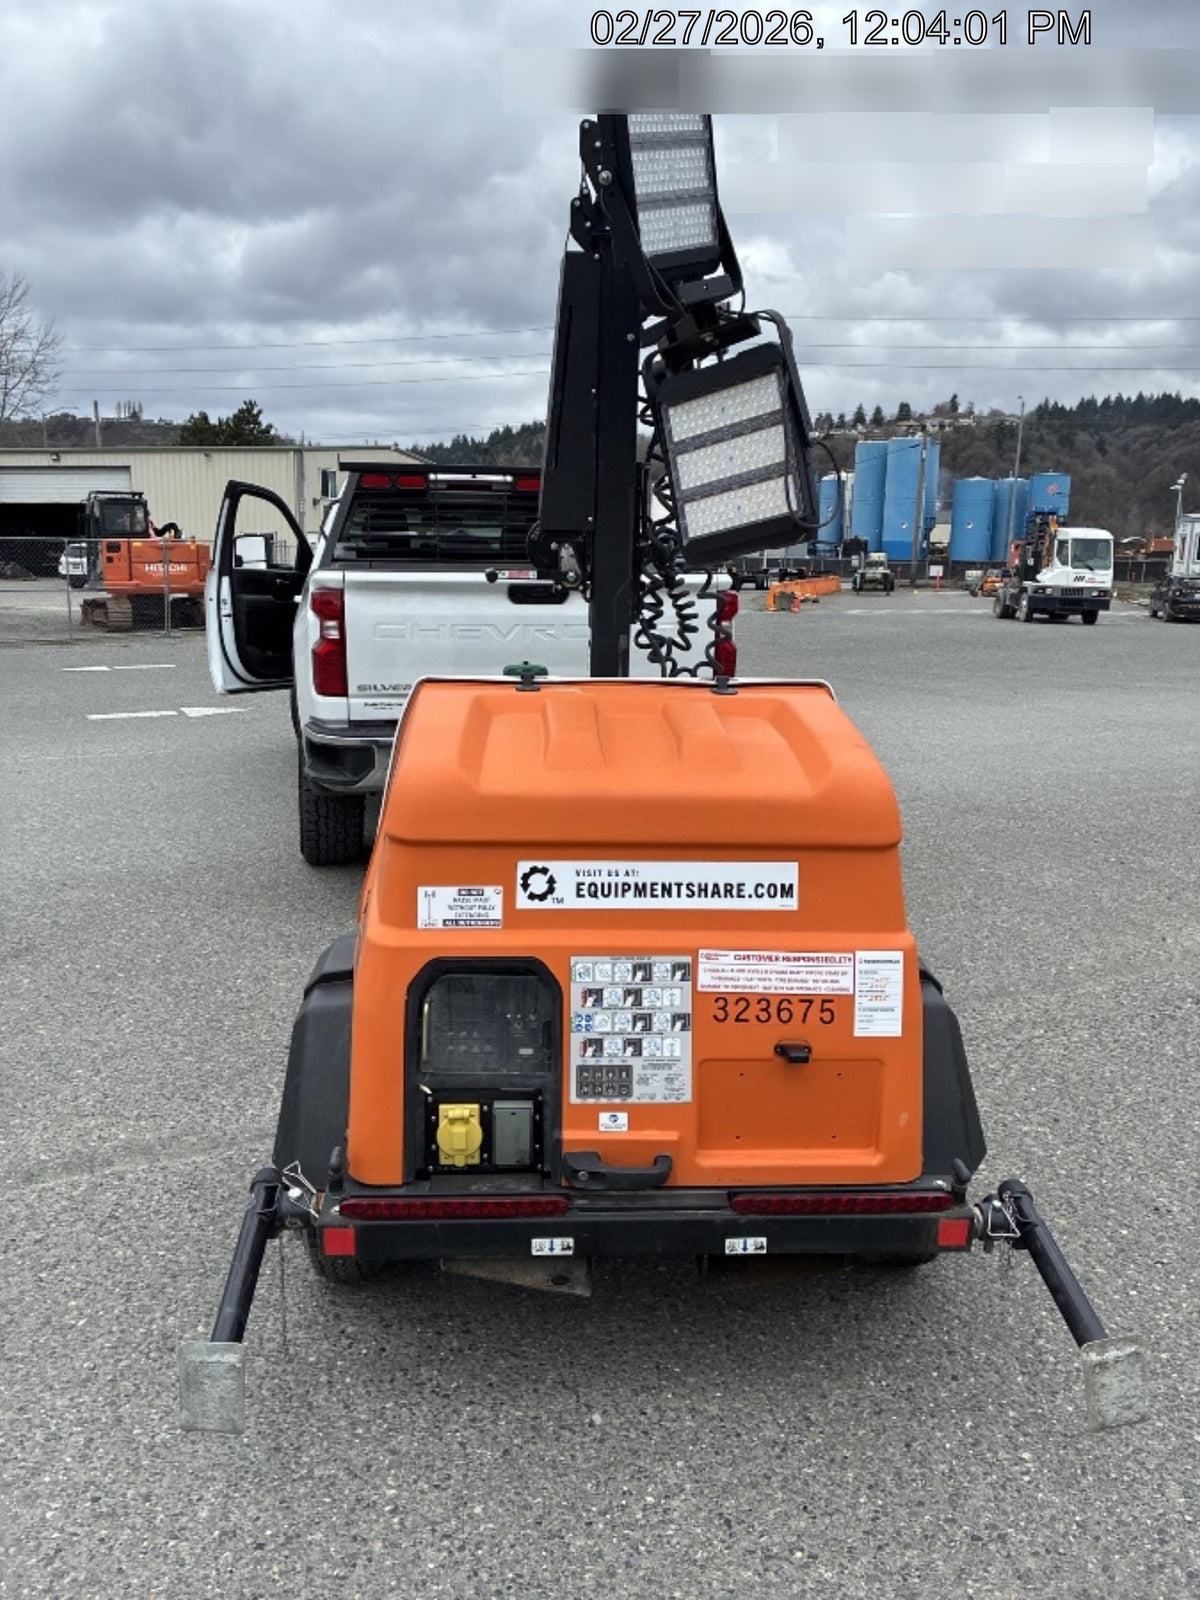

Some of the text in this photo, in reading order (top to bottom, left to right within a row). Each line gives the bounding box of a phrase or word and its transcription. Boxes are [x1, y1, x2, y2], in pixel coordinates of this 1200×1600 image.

[575, 869, 640, 877] VISIT US AT:
[575, 881, 795, 900] EQUIPMENTSHARE.COM
[733, 953, 781, 963] CUSTOMER
[712, 996, 836, 1025] 323675
